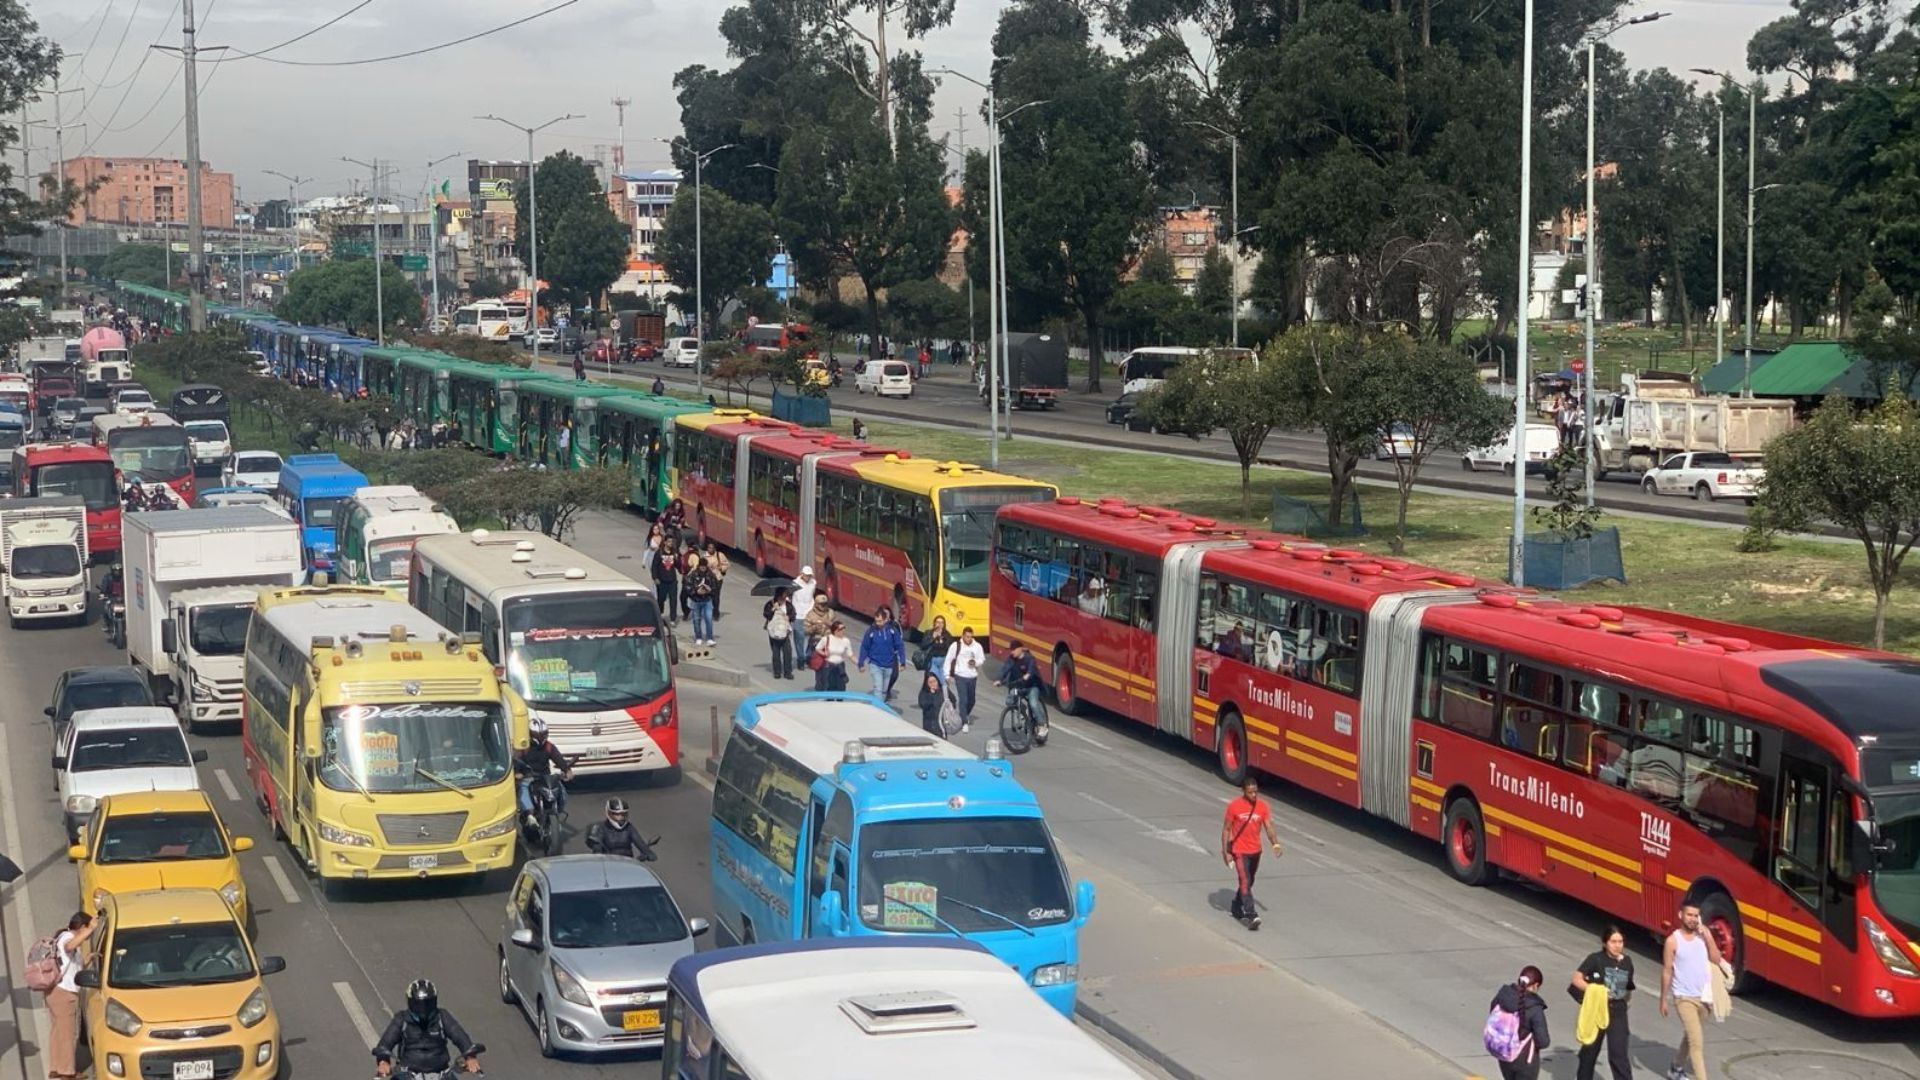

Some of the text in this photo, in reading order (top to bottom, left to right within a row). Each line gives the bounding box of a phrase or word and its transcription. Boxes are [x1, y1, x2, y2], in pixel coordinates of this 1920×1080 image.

[1248, 679, 1314, 720] TransMilenio
[1489, 762, 1585, 819] TransMilenio
[1640, 811, 1671, 846] T1444
